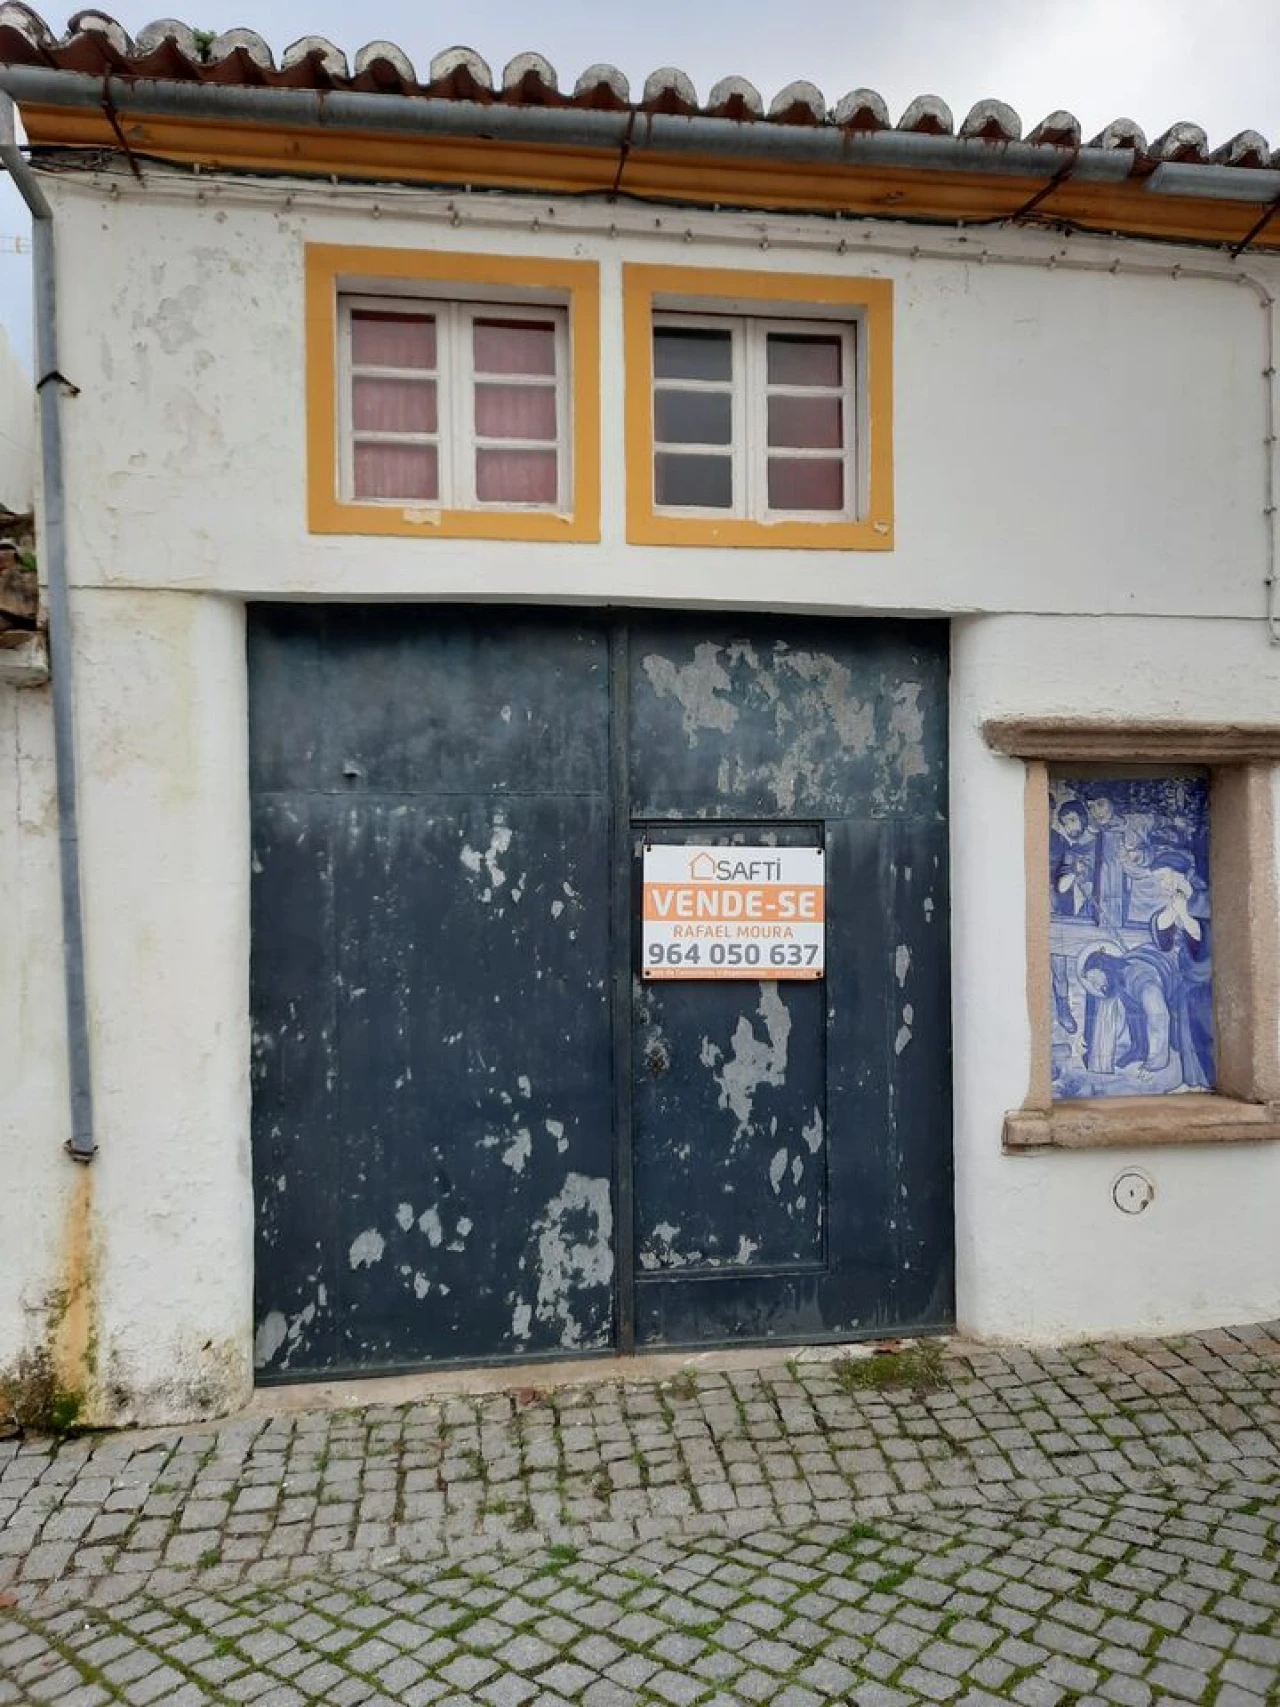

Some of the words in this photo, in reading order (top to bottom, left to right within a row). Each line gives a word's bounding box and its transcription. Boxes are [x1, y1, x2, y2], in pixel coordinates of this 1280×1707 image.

[651, 889, 817, 918] VENDE-SE
[673, 925, 733, 938] RAFAEL
[736, 926, 794, 939] MOURA
[648, 943, 700, 965] 964
[709, 943, 761, 965] 050
[769, 943, 819, 965] 637
